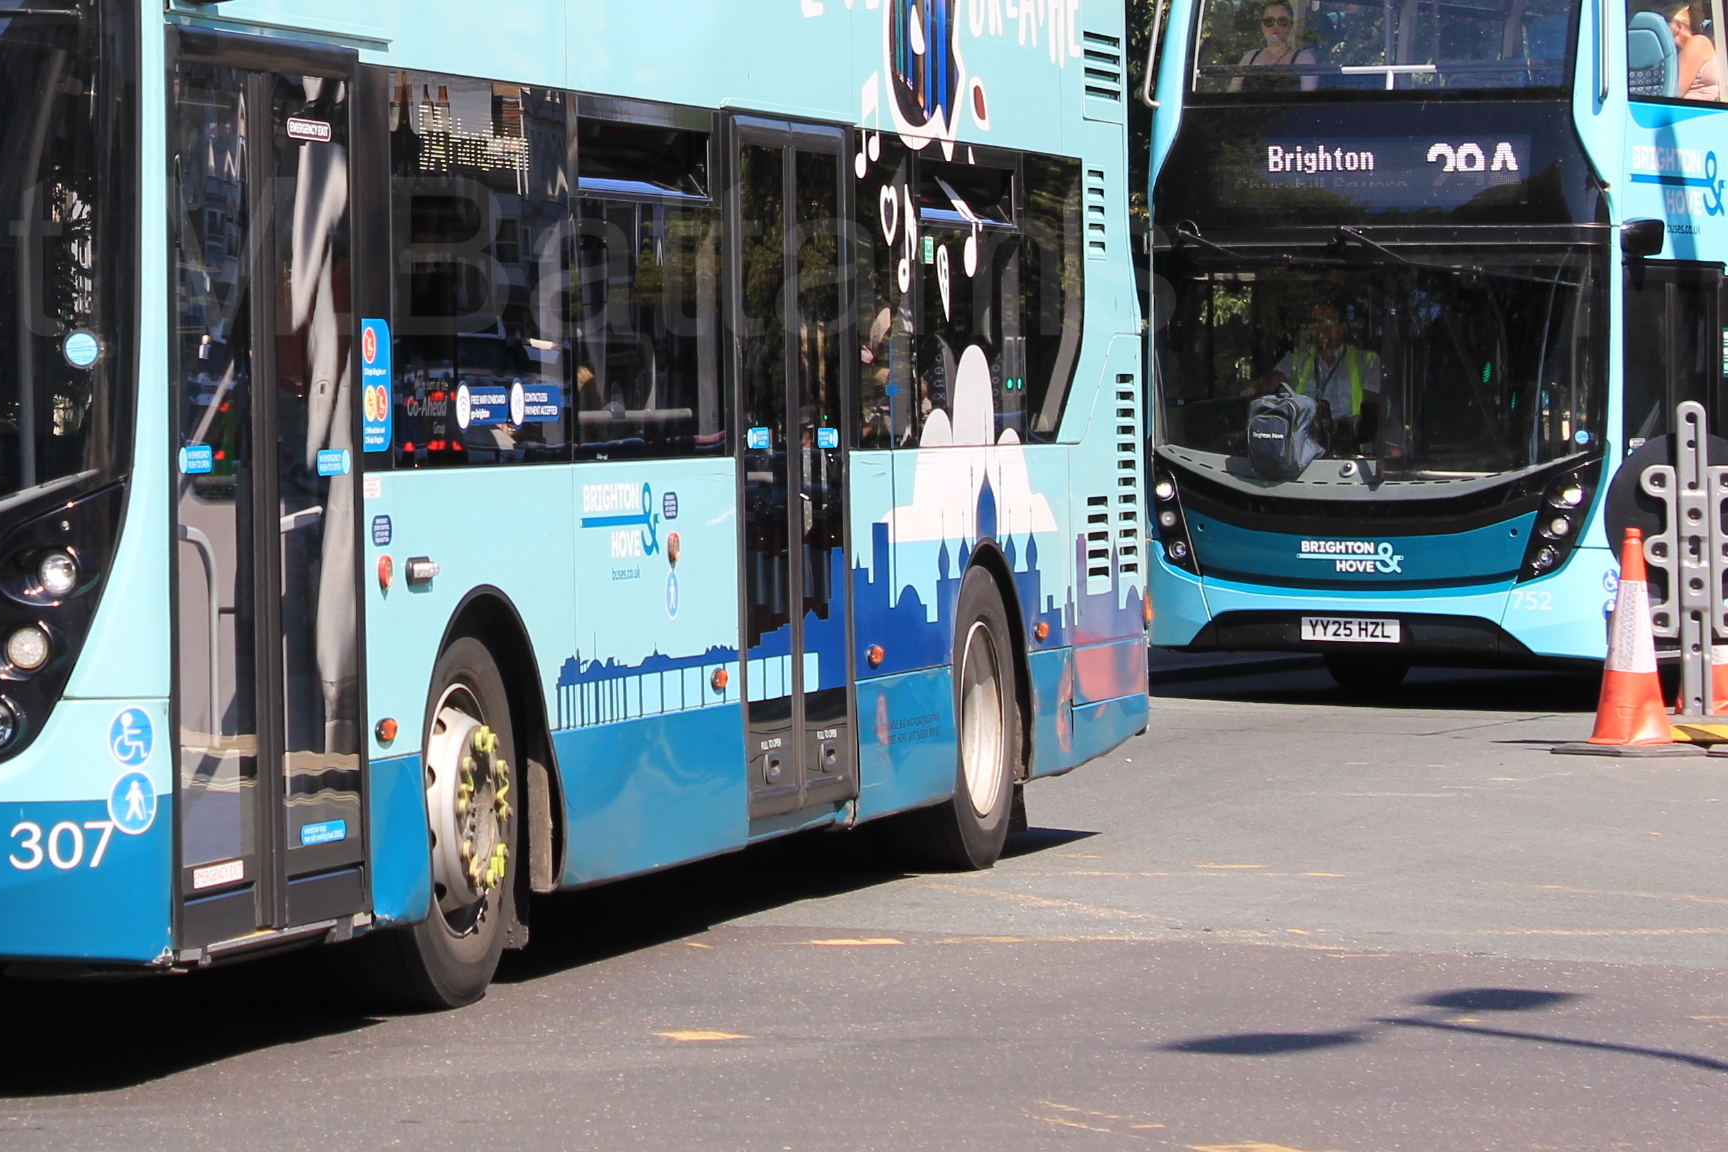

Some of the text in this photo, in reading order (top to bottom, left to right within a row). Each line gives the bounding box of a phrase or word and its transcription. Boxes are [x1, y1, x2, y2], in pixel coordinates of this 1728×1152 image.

[1267, 145, 1374, 174] Brighton
[1632, 146, 1702, 173] BRIGHTON
[1667, 190, 1702, 215] HOVE
[407, 395, 448, 417] Go-Ahead
[582, 483, 640, 512] BRIGHTON
[611, 530, 641, 558] HOVE
[1301, 540, 1374, 554] BRIGHTON
[611, 566, 641, 581] buses.co.uk
[1336, 560, 1375, 573] HOVE
[1513, 591, 1553, 610] 752
[1309, 619, 1391, 638] YY25 HZL
[9, 820, 115, 870] 307
[194, 862, 242, 885] EMERGENCY EXIT
